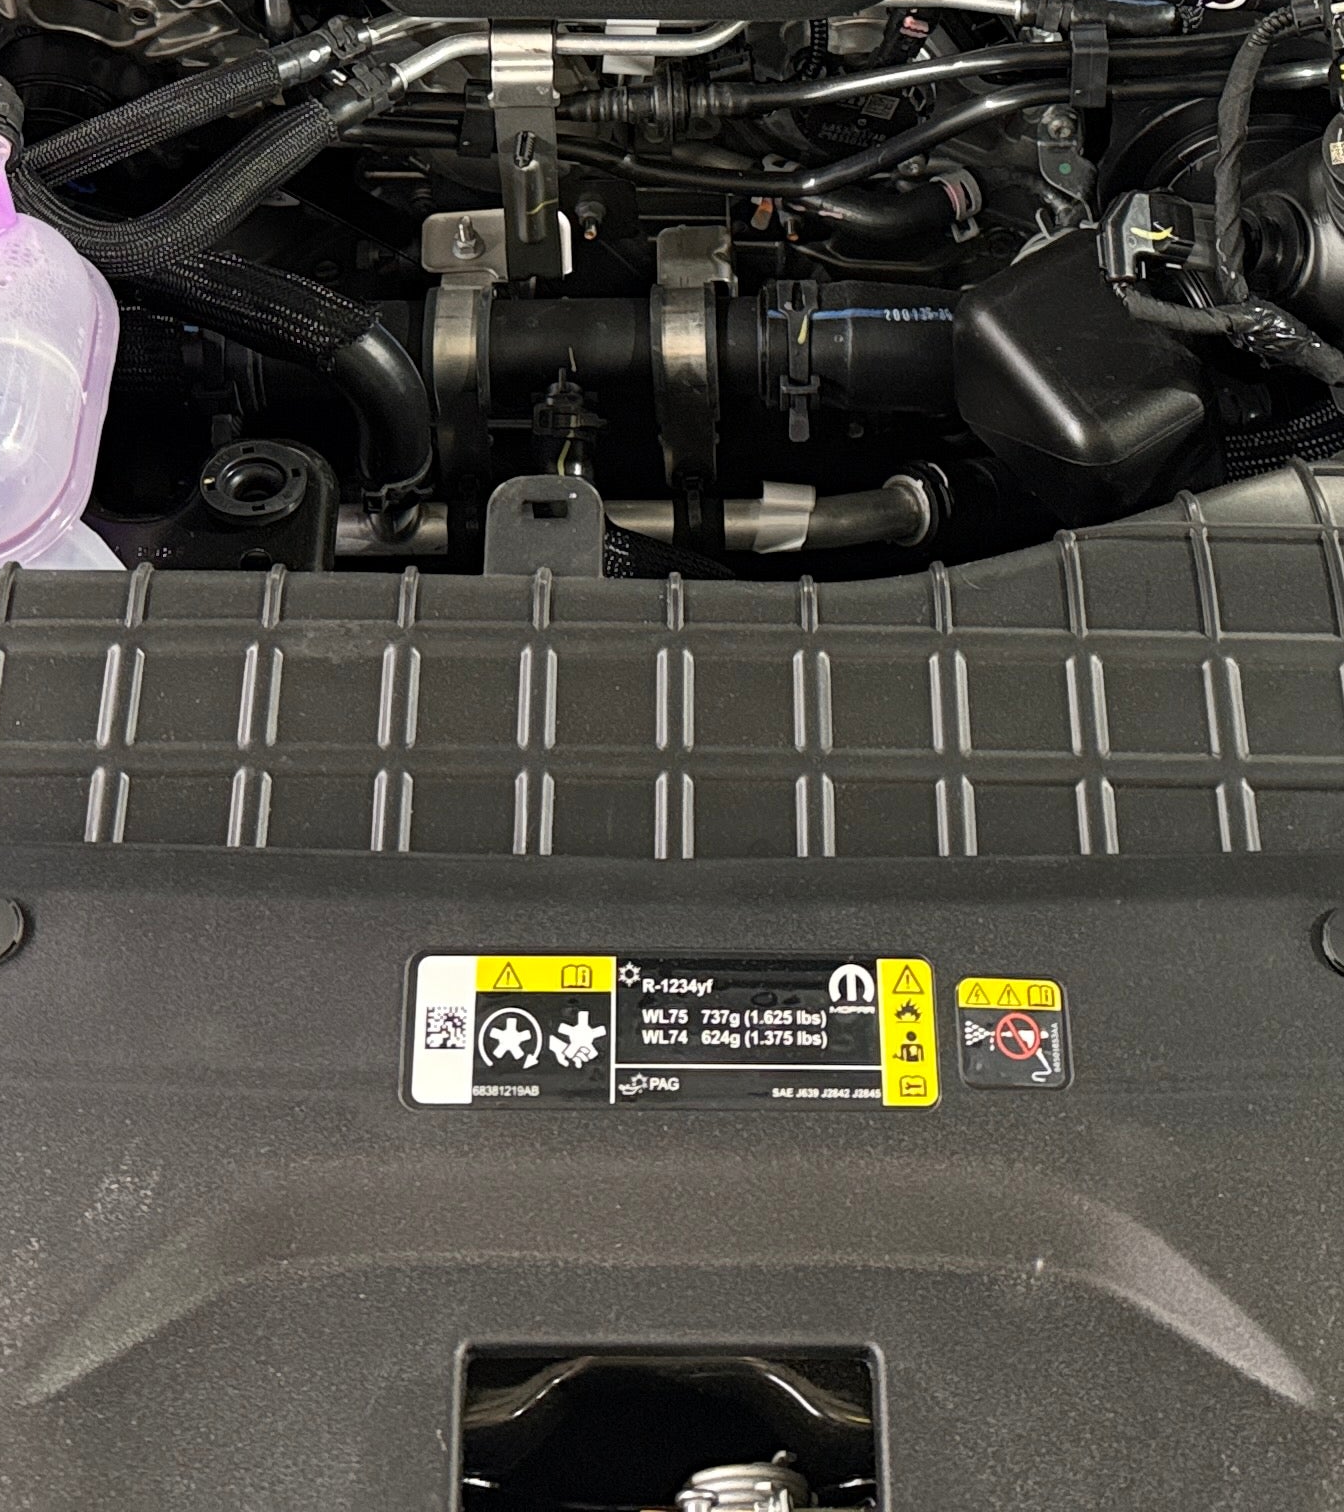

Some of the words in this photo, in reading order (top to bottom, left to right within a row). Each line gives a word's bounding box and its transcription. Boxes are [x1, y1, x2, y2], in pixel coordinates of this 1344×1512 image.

[641, 978, 713, 997] R-1234yf
[641, 1009, 689, 1024] WL75
[700, 1009, 740, 1027] 737g
[744, 1009, 793, 1028] (1.625
[796, 1009, 828, 1028] lbs)
[641, 1029, 689, 1044] WL74
[700, 1029, 741, 1048] 624g
[744, 1030, 794, 1048] (1.375
[796, 1030, 828, 1048] lbs)
[649, 1077, 680, 1091] PAG
[771, 1087, 793, 1098] SAE
